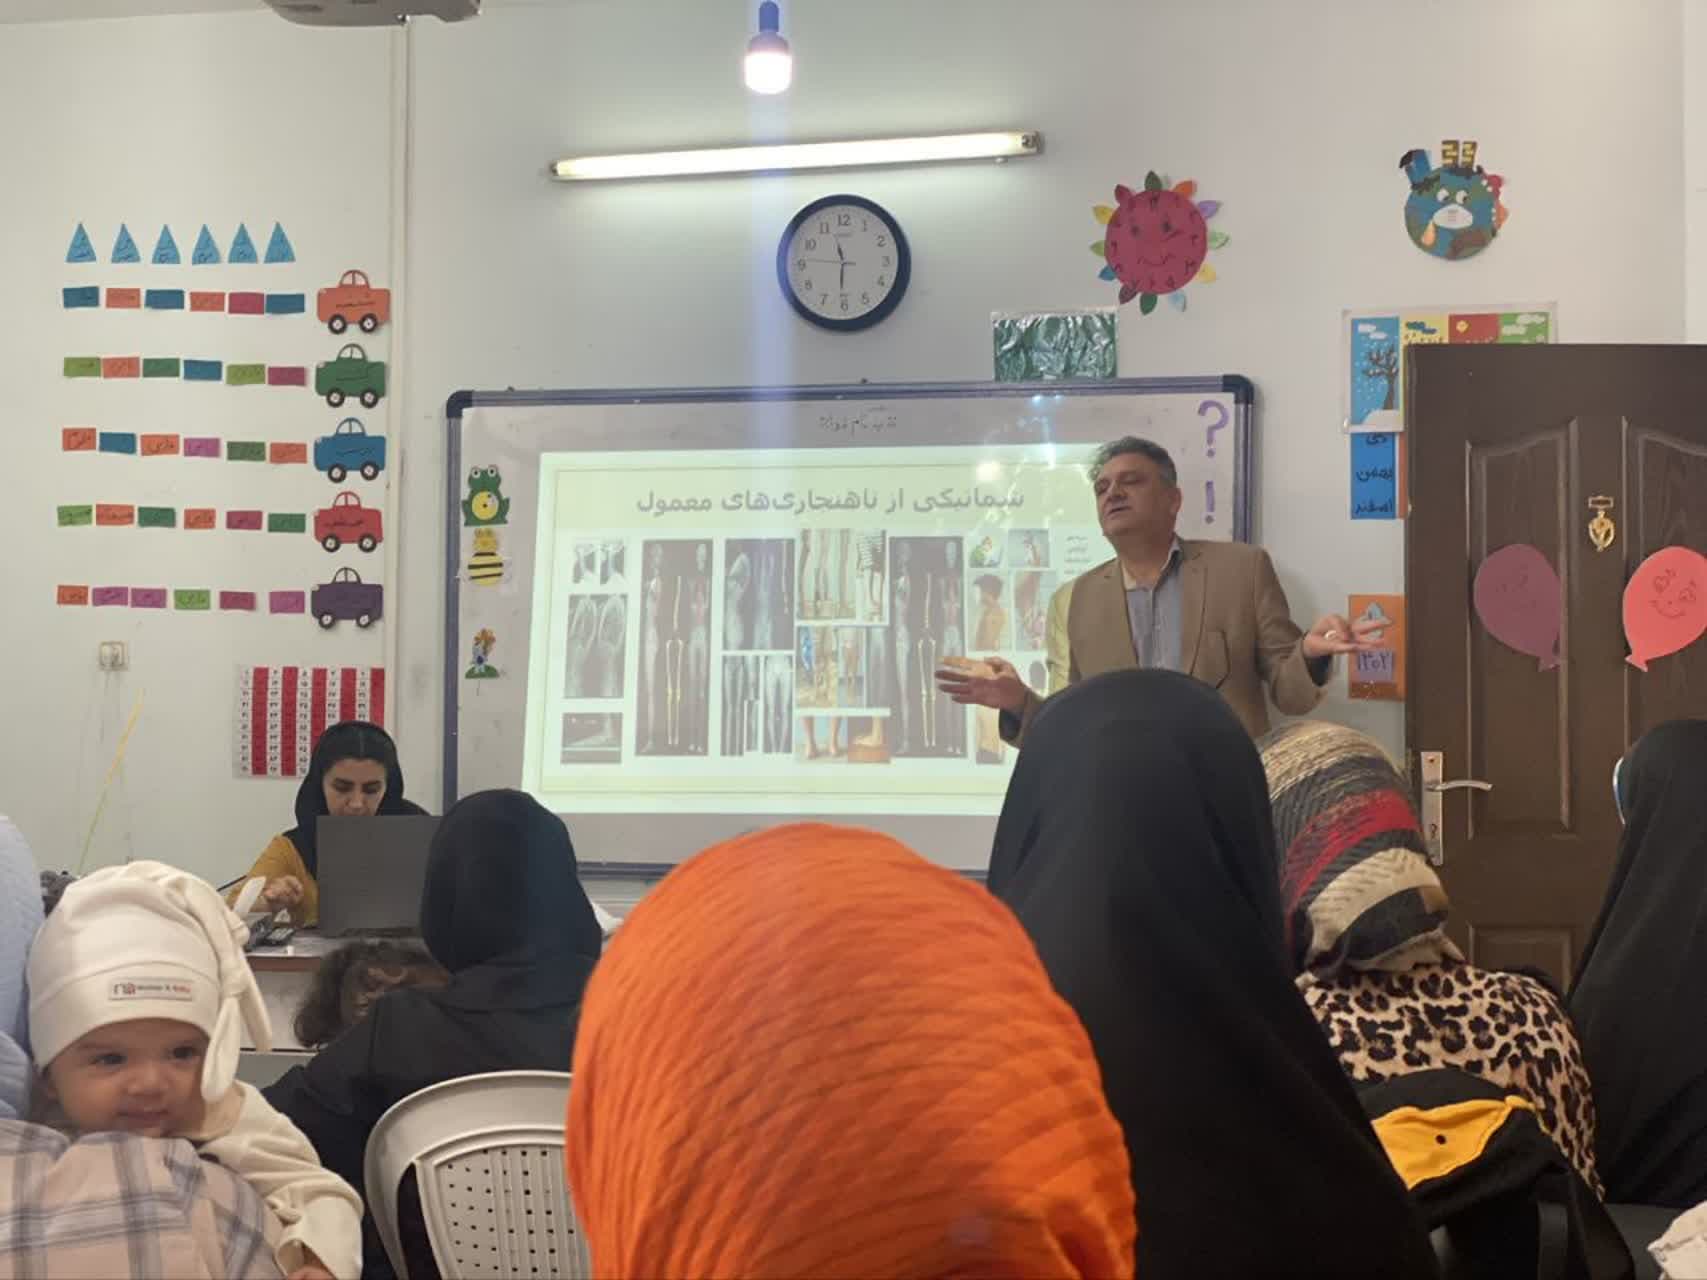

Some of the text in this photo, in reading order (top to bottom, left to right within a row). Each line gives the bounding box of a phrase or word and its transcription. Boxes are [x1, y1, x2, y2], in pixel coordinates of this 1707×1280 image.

[837, 214, 851, 226] 12
[862, 220, 868, 232] 1
[819, 222, 830, 234] 11
[805, 239, 816, 250] 10
[877, 235, 887, 247] 2
[798, 258, 806, 271] 9
[881, 256, 890, 267] 3
[804, 280, 812, 290] 8
[877, 275, 885, 286] 4
[820, 293, 828, 306] 7
[862, 292, 870, 304] 5
[840, 299, 849, 311] 6
[1197, 399, 1229, 459] ?
[636, 490, 713, 518] معمول
